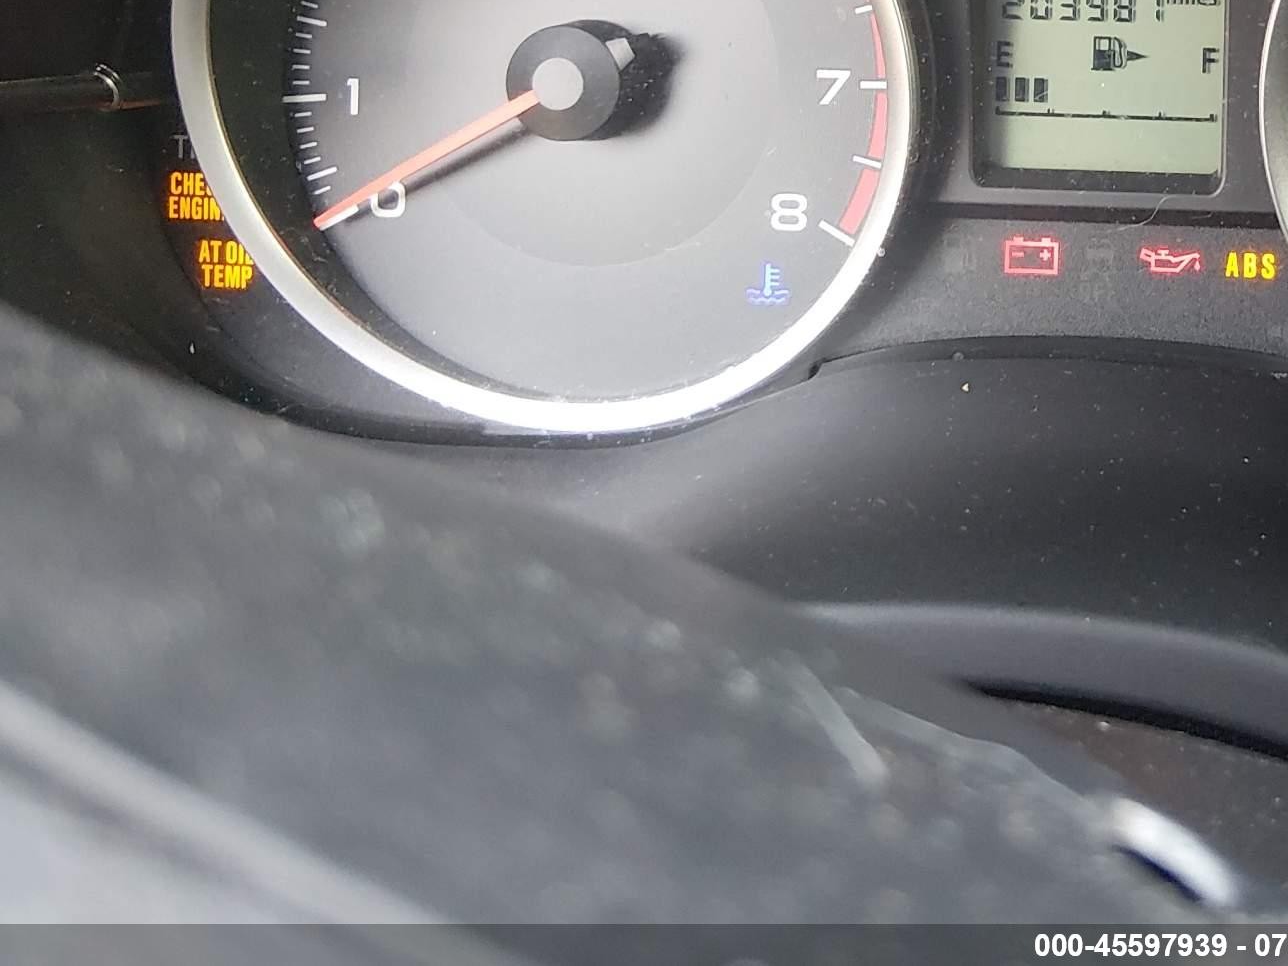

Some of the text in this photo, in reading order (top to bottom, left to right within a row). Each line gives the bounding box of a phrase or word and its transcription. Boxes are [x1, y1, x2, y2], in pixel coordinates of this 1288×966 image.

[996, 40, 1014, 69] E
[1202, 47, 1220, 74] F
[346, 78, 359, 116] 1
[816, 69, 851, 105] 7
[170, 171, 214, 196] CHE
[168, 197, 225, 221] ENGIN
[370, 180, 406, 218] 0
[768, 193, 808, 232] 8
[198, 239, 223, 264] AT
[1225, 251, 1277, 280] ABS
[201, 264, 253, 290] TEMP
